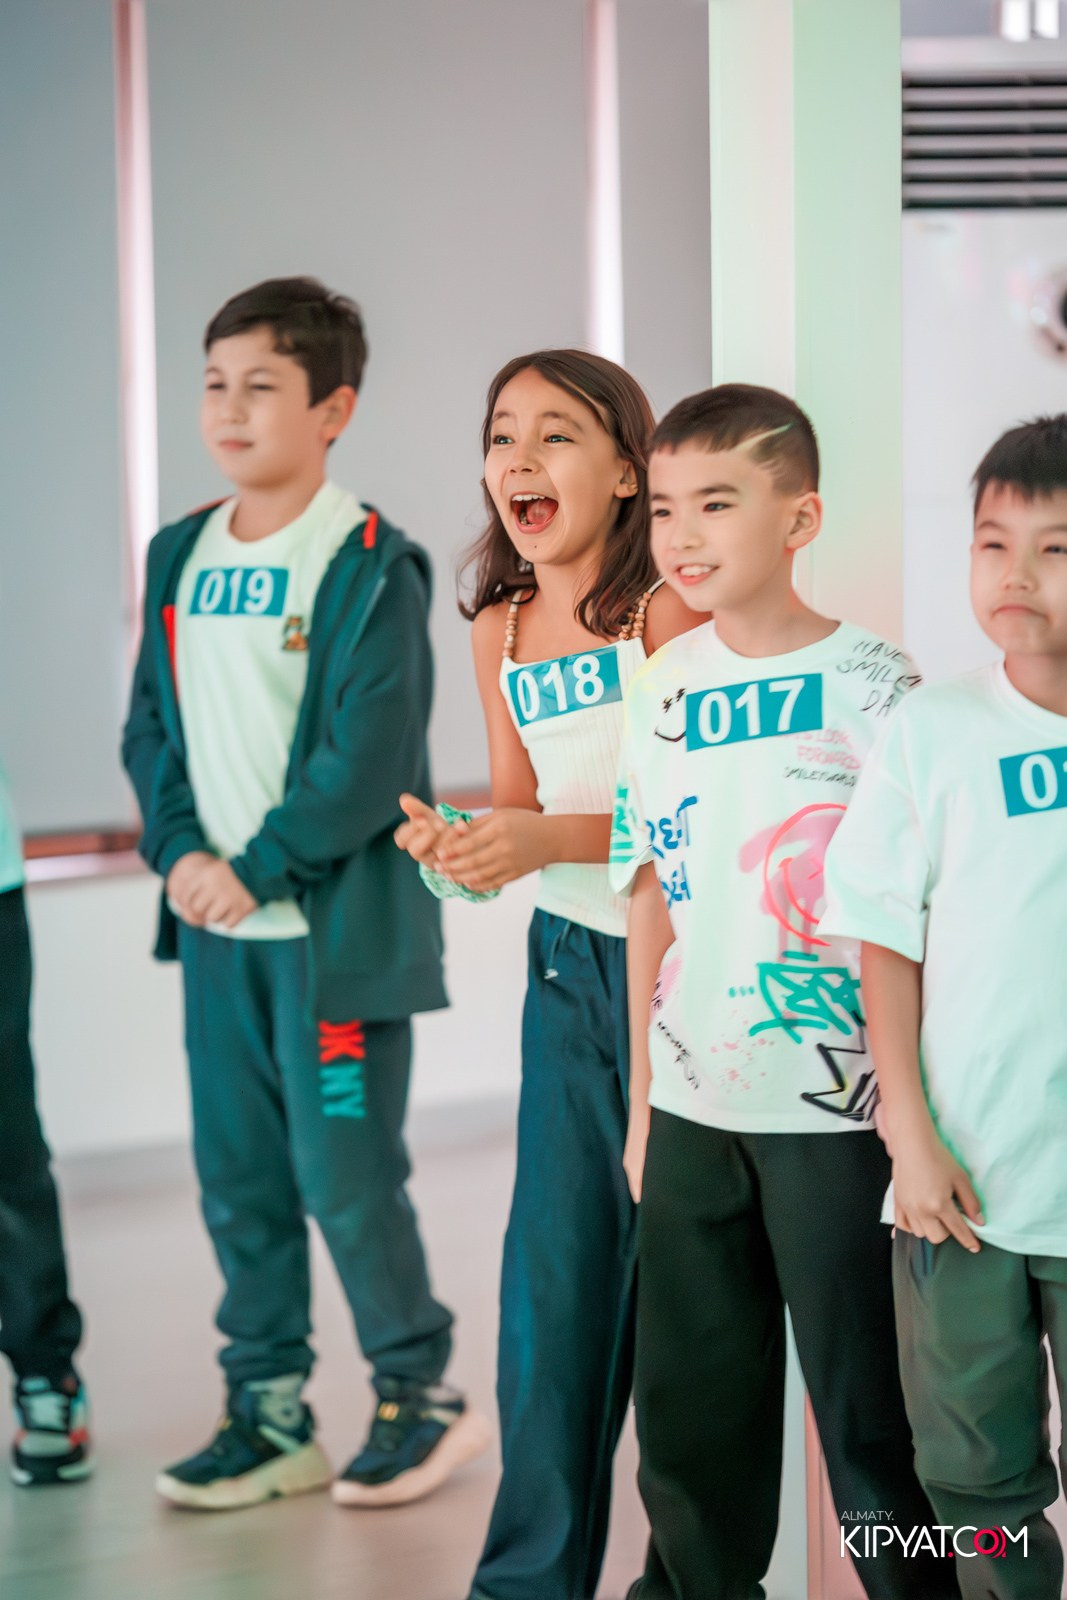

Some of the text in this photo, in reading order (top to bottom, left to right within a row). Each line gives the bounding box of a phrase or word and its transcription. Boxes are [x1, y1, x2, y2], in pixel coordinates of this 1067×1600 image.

[198, 568, 274, 614] 019
[516, 654, 605, 721] 018
[698, 678, 806, 744] 017
[859, 689, 896, 717] DA
